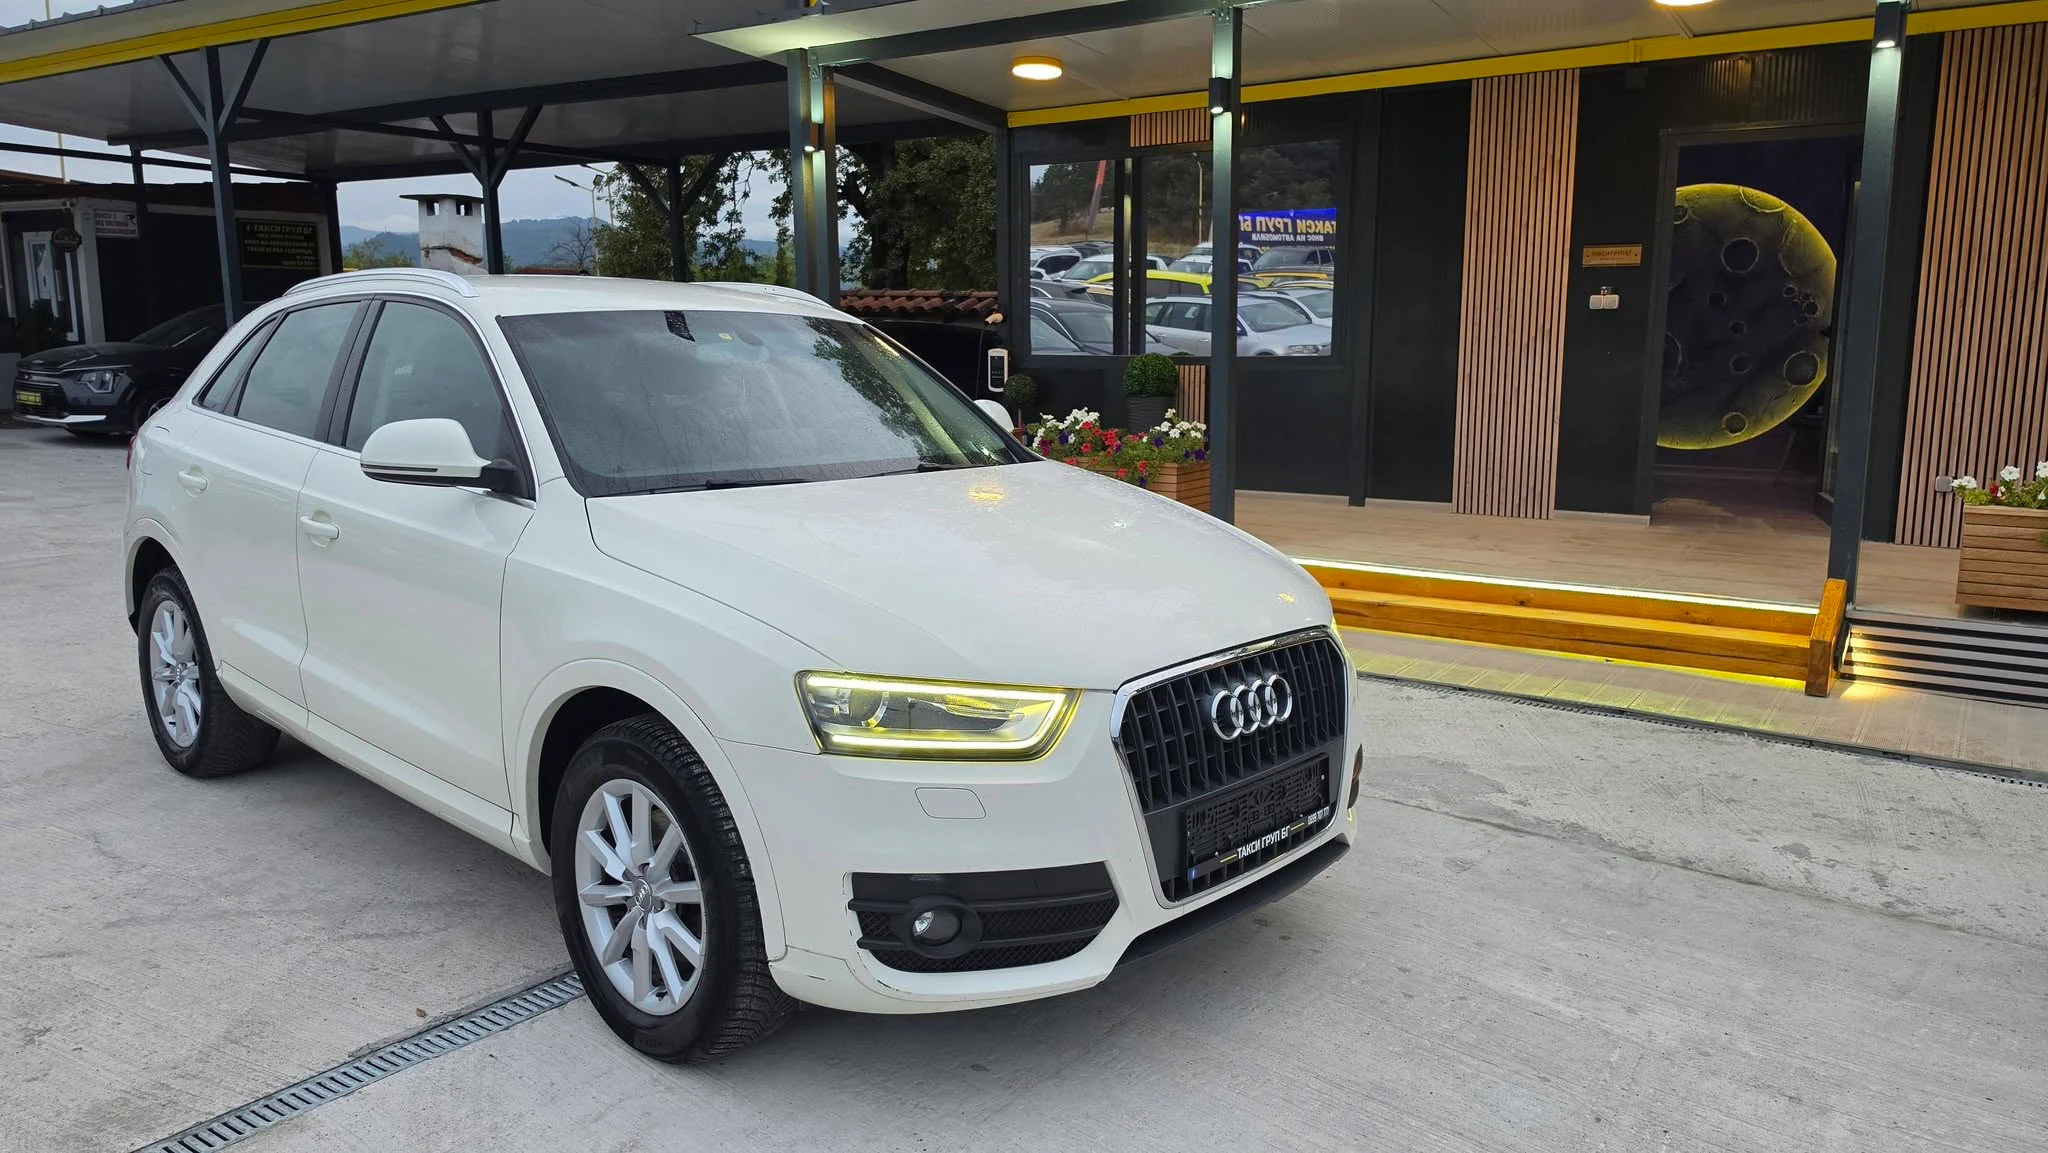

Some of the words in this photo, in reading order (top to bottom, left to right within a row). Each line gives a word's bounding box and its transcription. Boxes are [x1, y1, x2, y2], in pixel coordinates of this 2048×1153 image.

[1237, 837, 1261, 859] ТАКСИ
[1261, 829, 1281, 848] ГРУП
[1281, 825, 1291, 840] БГ
